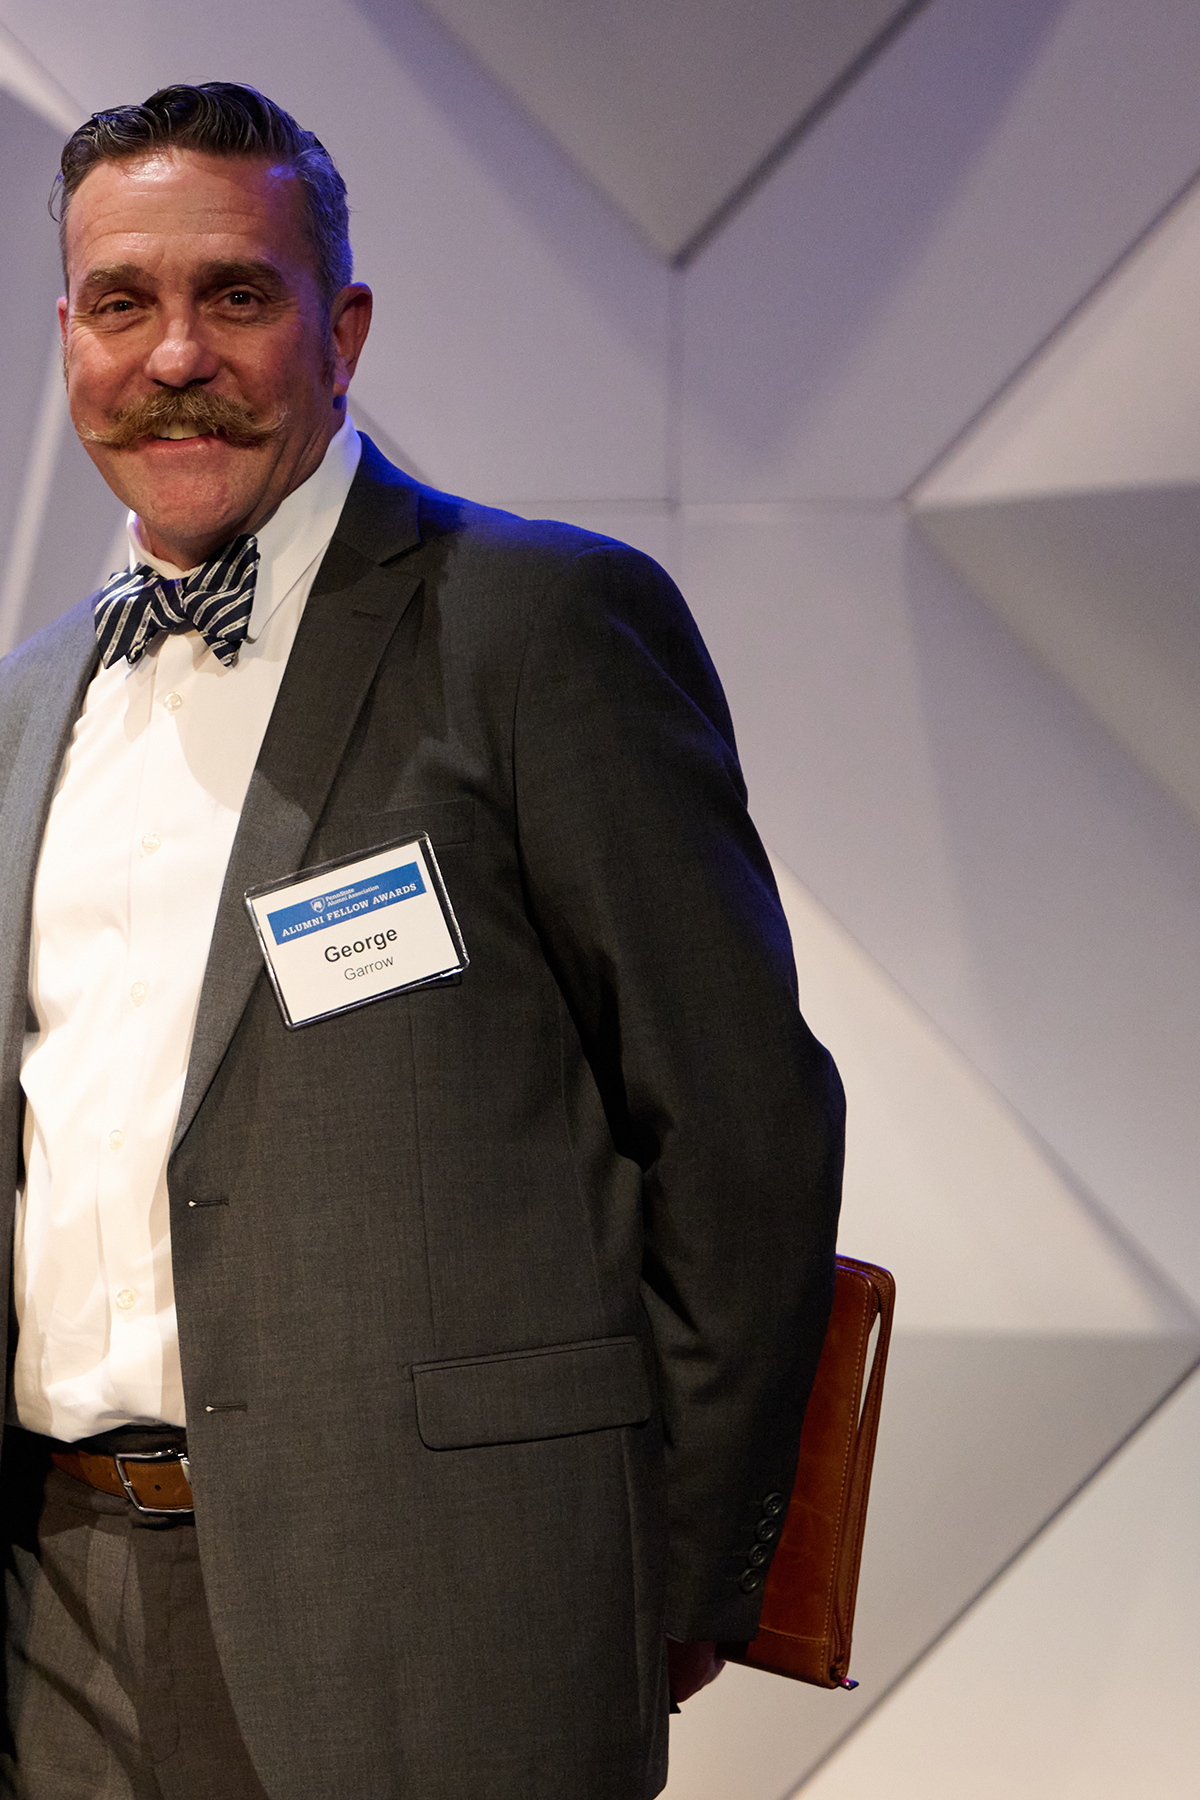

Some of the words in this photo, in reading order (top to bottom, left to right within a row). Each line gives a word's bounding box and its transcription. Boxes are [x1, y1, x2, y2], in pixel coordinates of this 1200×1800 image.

[325, 887, 355, 902] PennState
[327, 896, 348, 907] Alumni
[348, 885, 380, 901] Association
[282, 915, 325, 937] ALUMNI
[326, 899, 370, 921] FELLOW
[372, 882, 417, 905] AWARDS
[324, 927, 399, 963] George
[343, 955, 395, 981] Garrow
